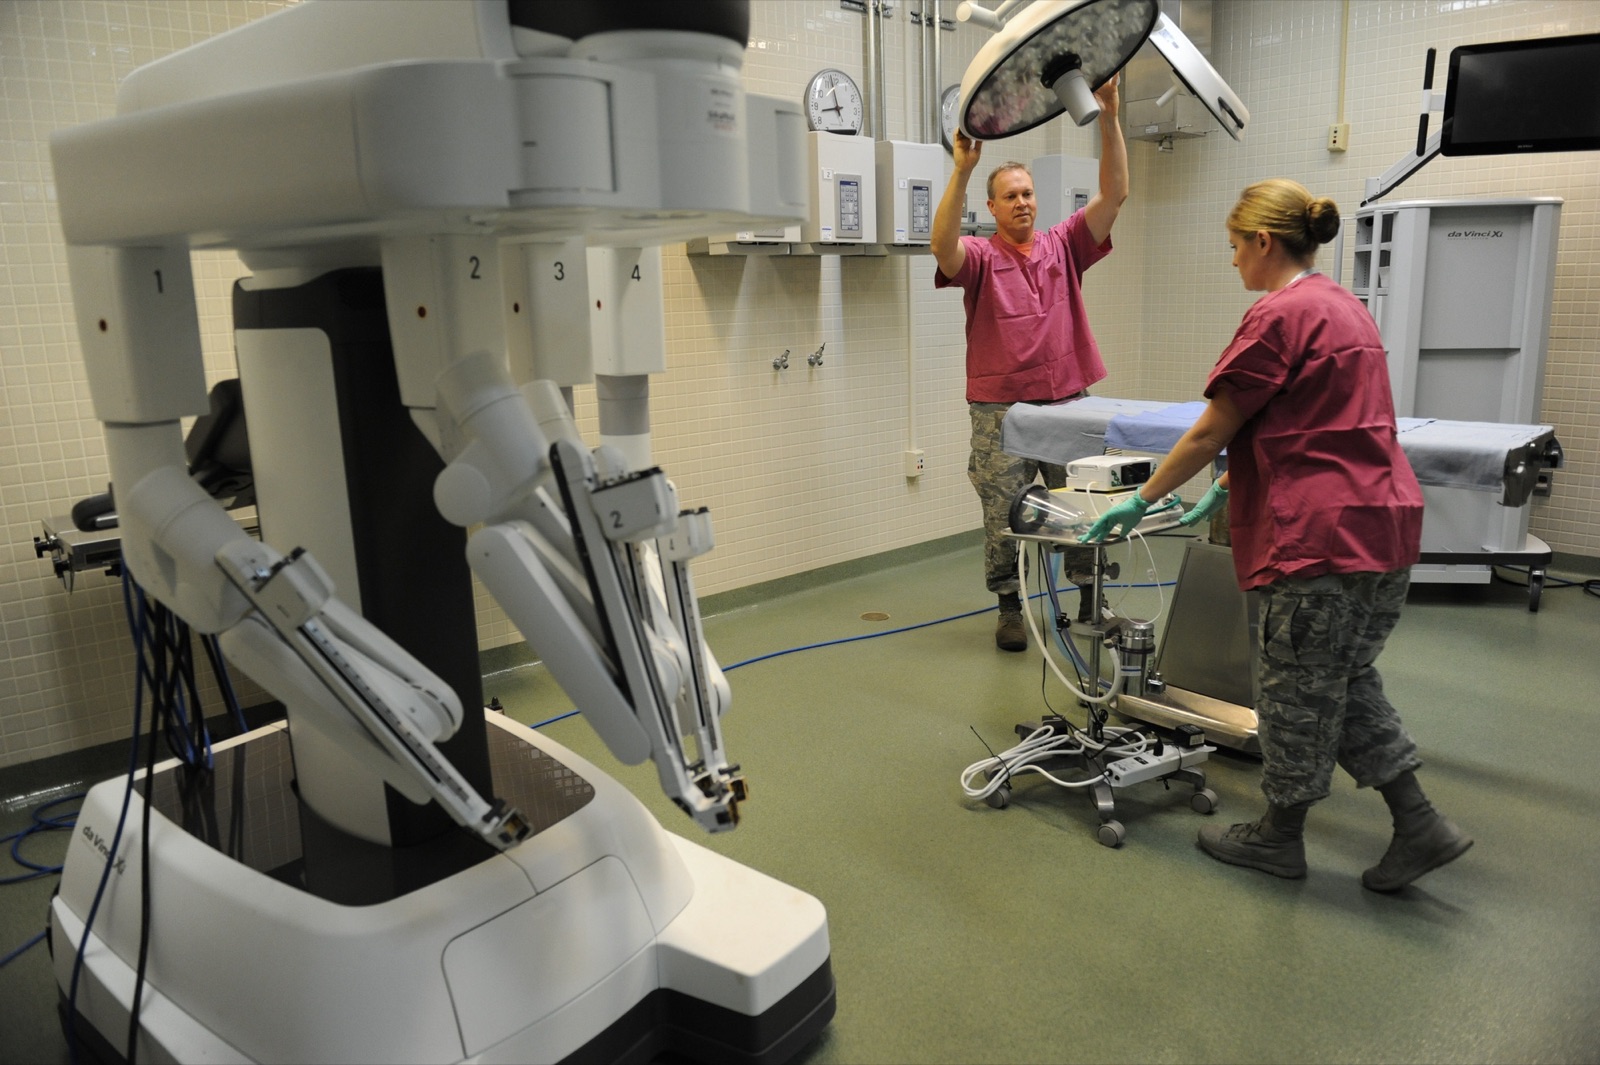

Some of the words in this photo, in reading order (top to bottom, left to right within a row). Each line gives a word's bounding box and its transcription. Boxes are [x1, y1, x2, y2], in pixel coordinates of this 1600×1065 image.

[818, 90, 824, 98] 10
[850, 94, 855, 103] 2
[814, 102, 818, 110] 9
[853, 108, 857, 116] 3
[469, 256, 481, 280] 2
[554, 262, 565, 280] 3
[631, 264, 642, 282] 4
[154, 269, 164, 294] 1
[610, 510, 623, 528] 2
